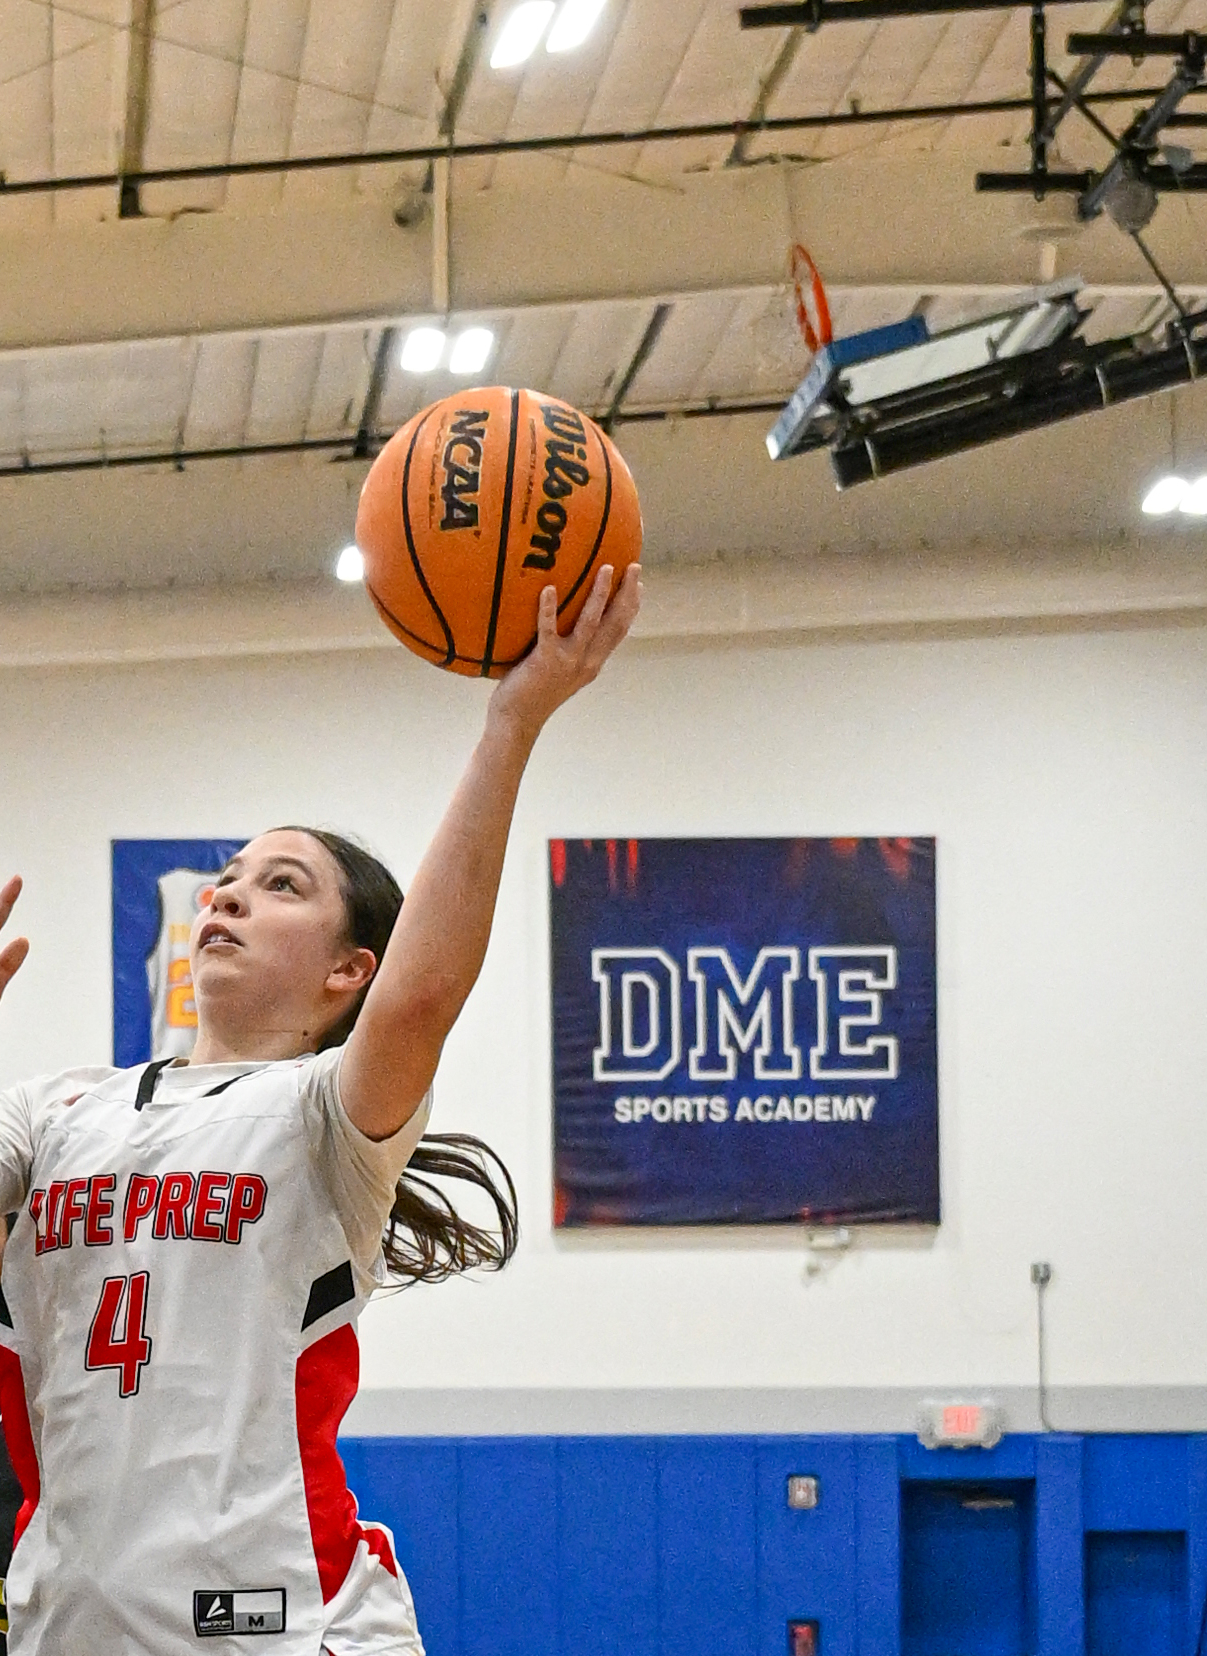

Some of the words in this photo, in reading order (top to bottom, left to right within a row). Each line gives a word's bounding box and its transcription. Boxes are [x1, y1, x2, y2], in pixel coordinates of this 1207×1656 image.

[439, 409, 490, 532] NCAA
[522, 403, 591, 571] Wilson
[592, 946, 898, 1082] DME
[614, 1096, 731, 1123] SPORTS
[734, 1096, 877, 1123] ACADEMY
[29, 1173, 116, 1256] LIFE
[123, 1171, 268, 1245] PREP
[84, 1270, 152, 1398] 4
[248, 1615, 265, 1627] M
